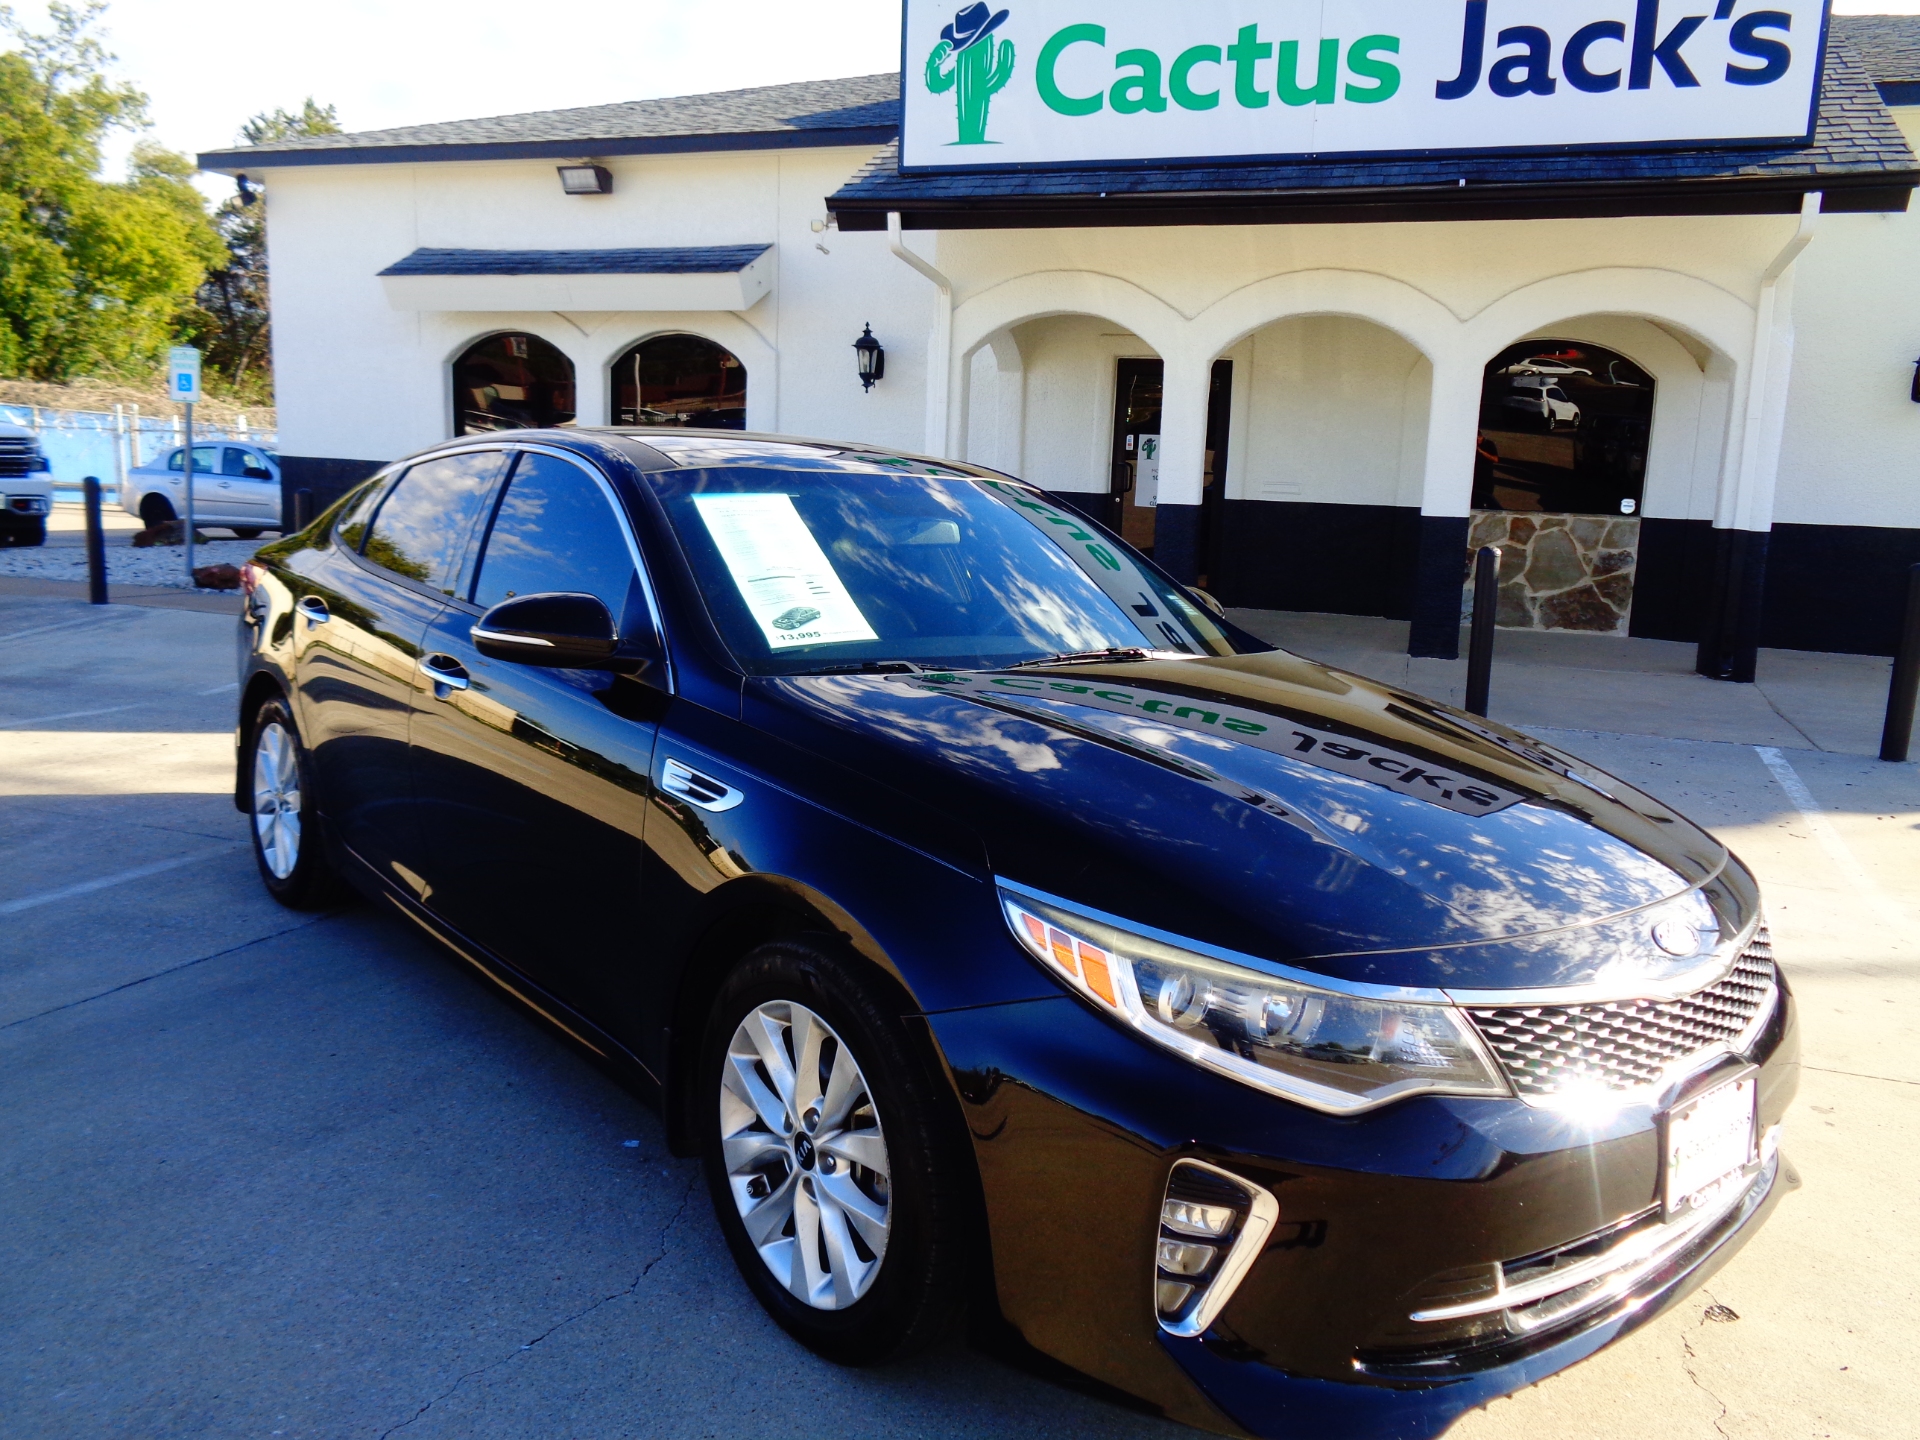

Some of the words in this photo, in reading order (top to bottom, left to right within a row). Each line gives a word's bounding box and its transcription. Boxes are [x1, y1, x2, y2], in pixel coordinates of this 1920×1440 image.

[1035, 23, 1401, 117] Cactus
[1435, 0, 1792, 99] Jack's
[797, 1140, 811, 1164] KIA
